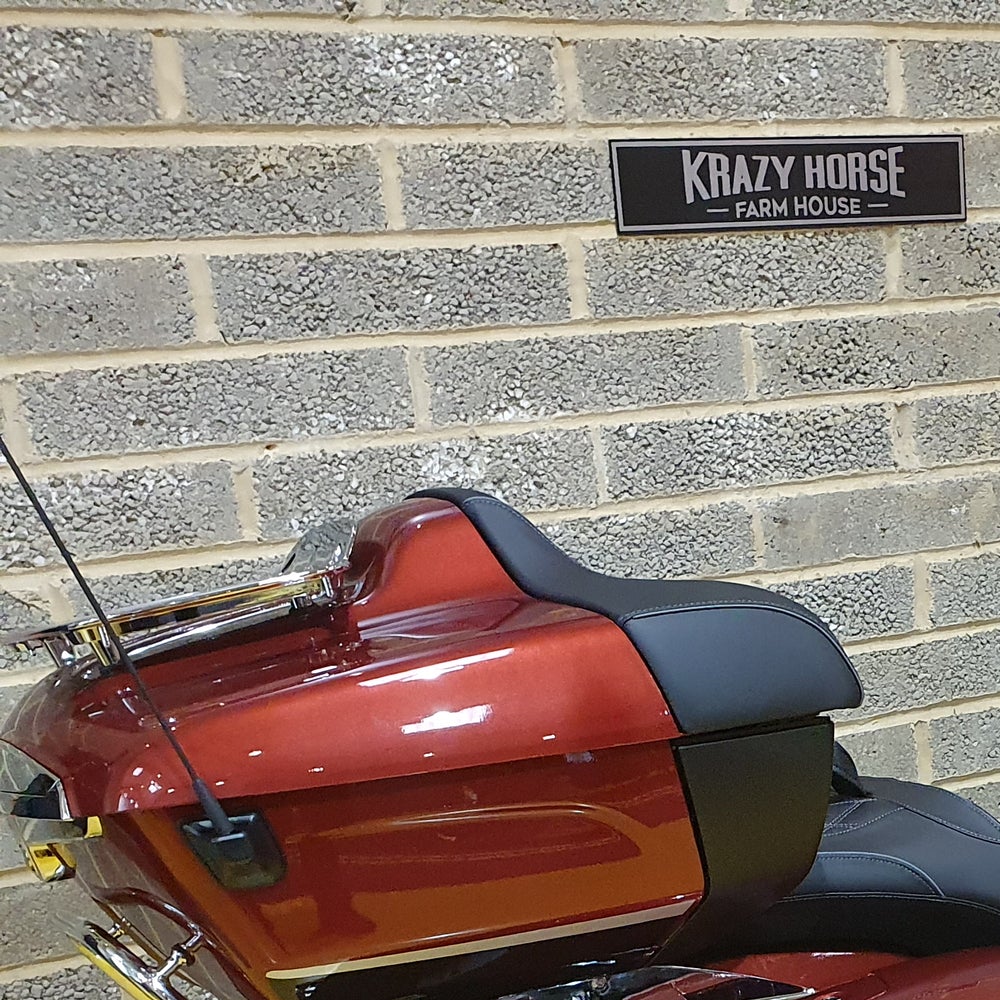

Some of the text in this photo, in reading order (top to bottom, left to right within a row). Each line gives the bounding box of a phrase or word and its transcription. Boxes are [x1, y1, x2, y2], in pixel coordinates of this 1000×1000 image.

[682, 146, 906, 204] KRAZY HORSE
[735, 196, 862, 219] FARM HOUSE
